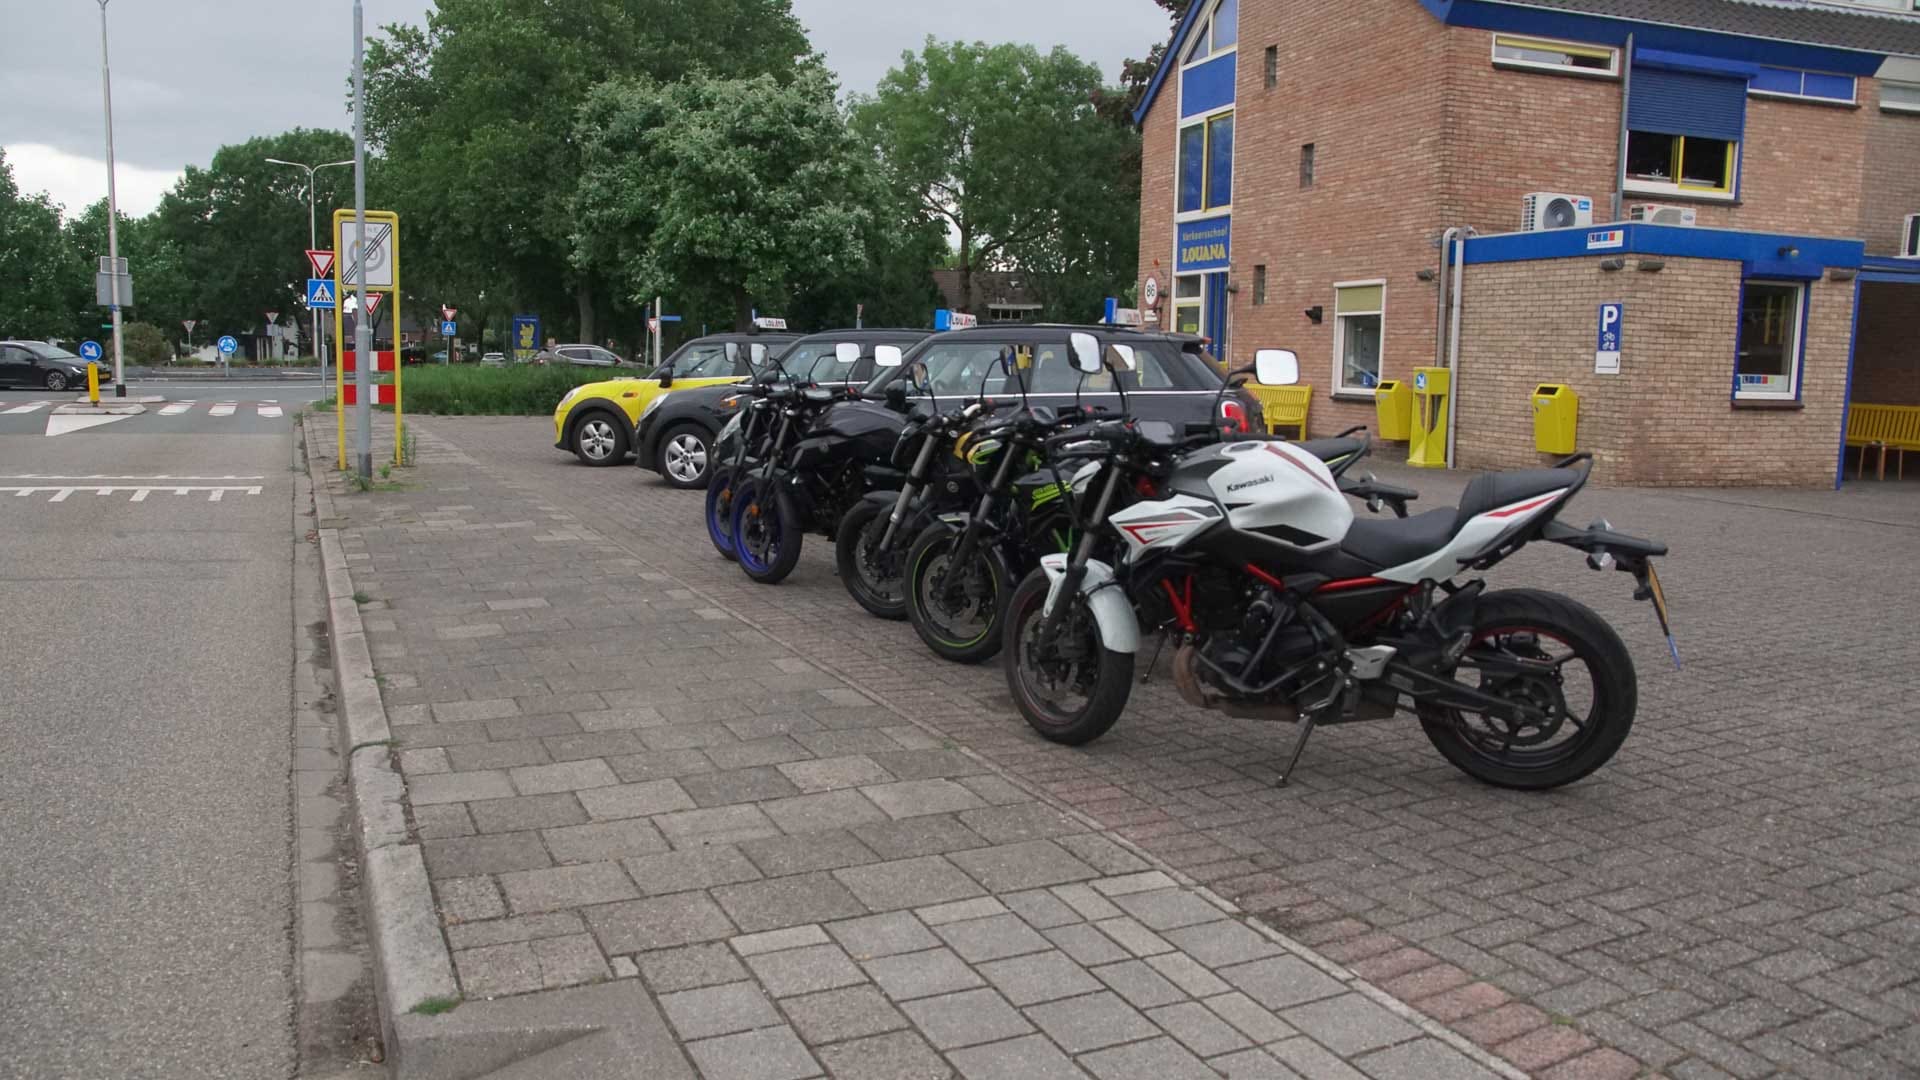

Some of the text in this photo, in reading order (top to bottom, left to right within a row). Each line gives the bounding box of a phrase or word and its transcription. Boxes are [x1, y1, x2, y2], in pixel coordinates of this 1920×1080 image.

[1182, 243, 1226, 263] LOUANA
[1602, 305, 1618, 332] P
[1226, 474, 1275, 493] Kawasaki
